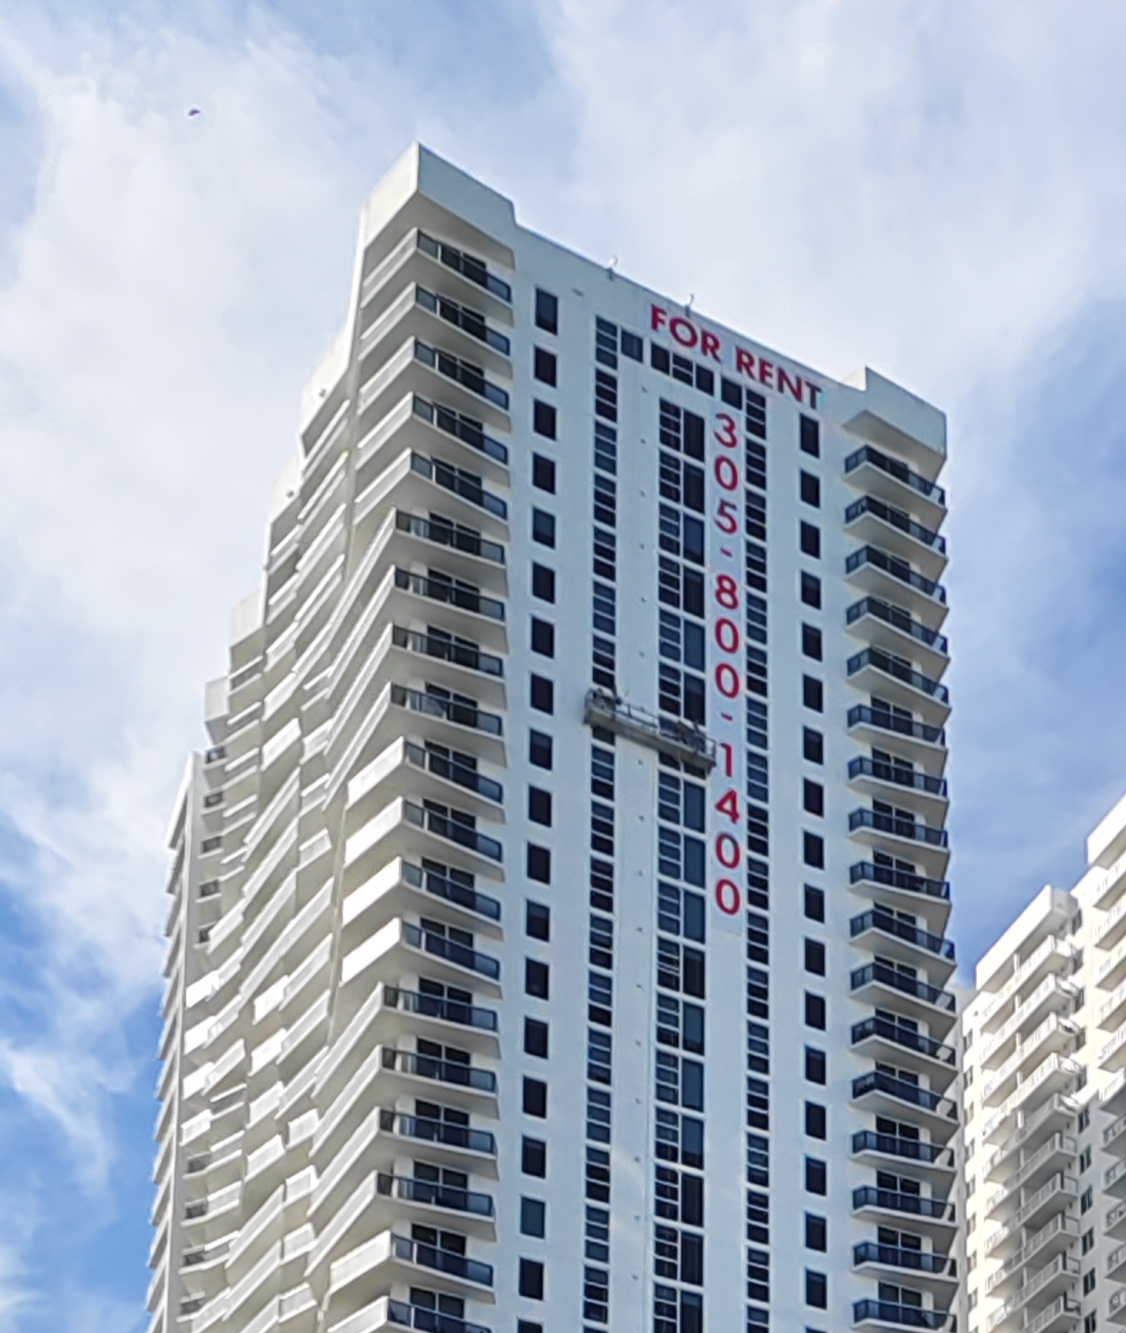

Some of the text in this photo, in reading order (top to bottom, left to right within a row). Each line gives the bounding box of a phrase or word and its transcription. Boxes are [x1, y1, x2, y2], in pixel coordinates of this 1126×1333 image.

[651, 304, 823, 410] FOR RENT
[714, 413, 741, 916] 305-800-1400
